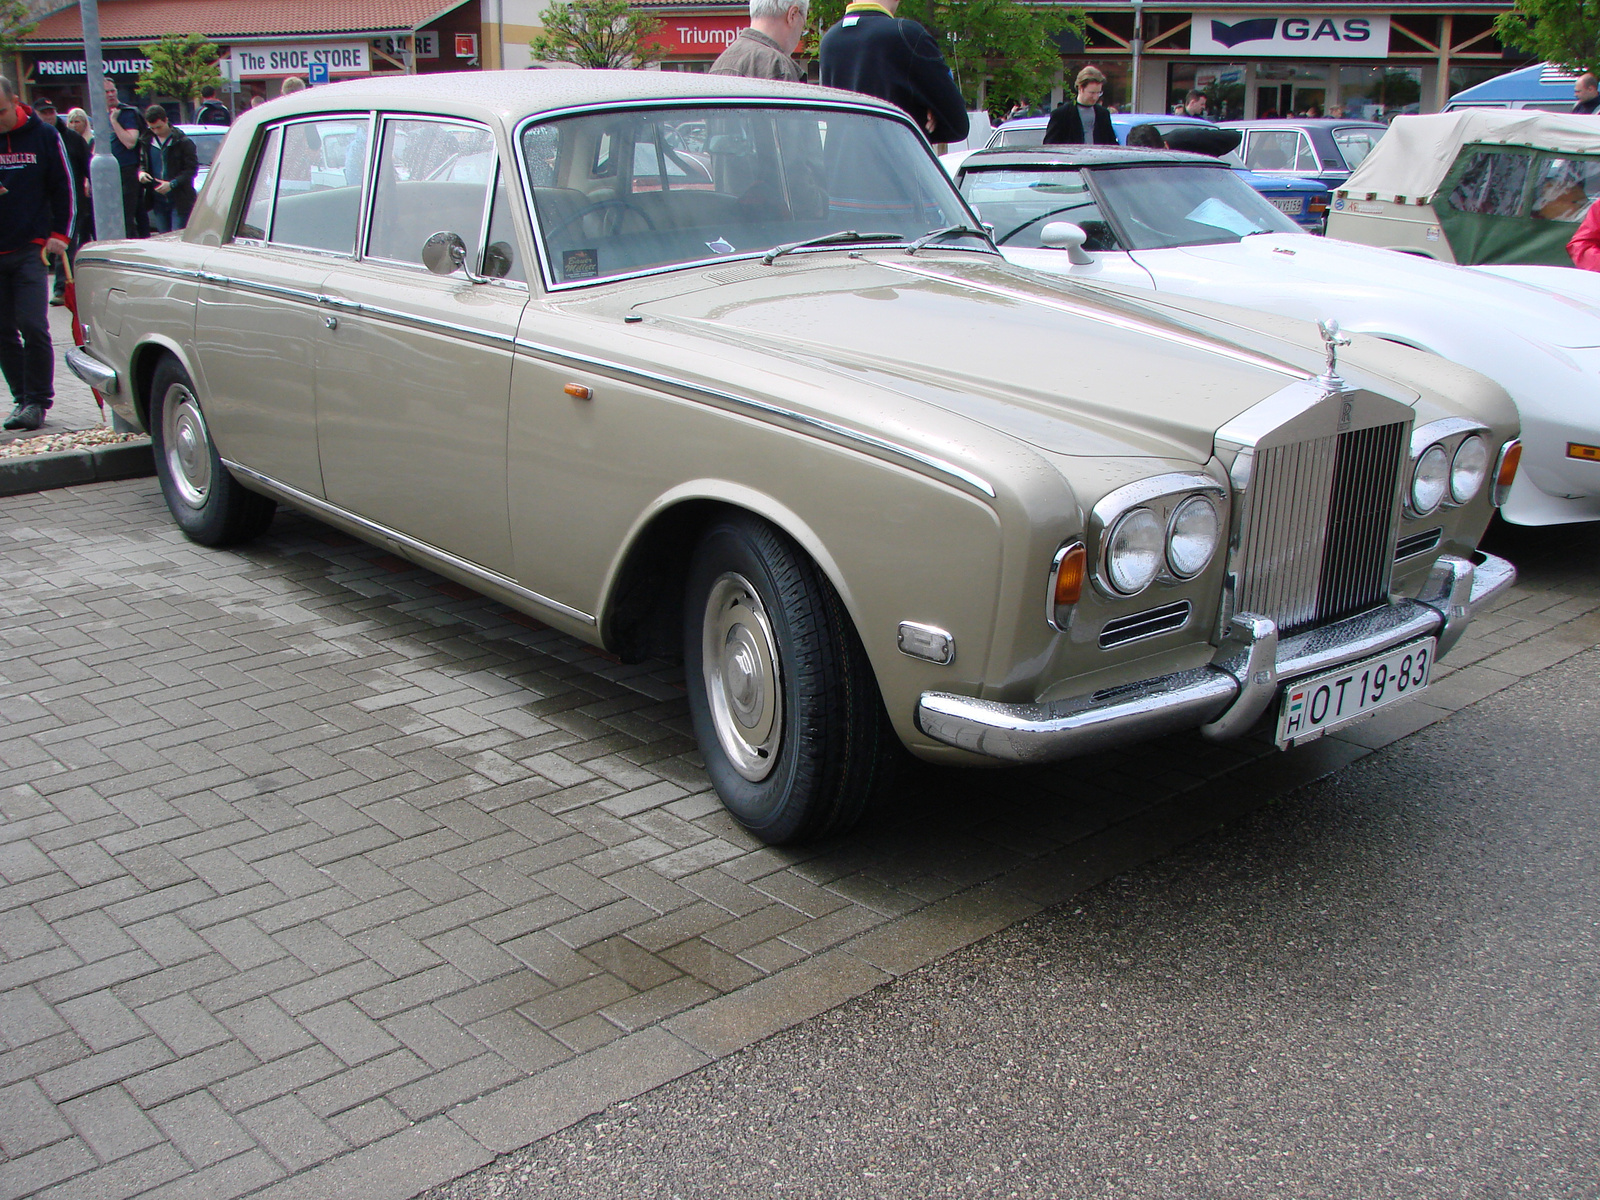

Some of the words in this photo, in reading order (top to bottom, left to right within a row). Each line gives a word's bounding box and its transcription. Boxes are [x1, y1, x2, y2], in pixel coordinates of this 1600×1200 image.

[1282, 18, 1371, 42] GAS
[239, 53, 265, 70] The
[270, 51, 308, 69] SHOE
[313, 49, 361, 67] STORE
[312, 65, 325, 81] P
[1360, 648, 1427, 707] 19-83
[1286, 714, 1301, 734] H
